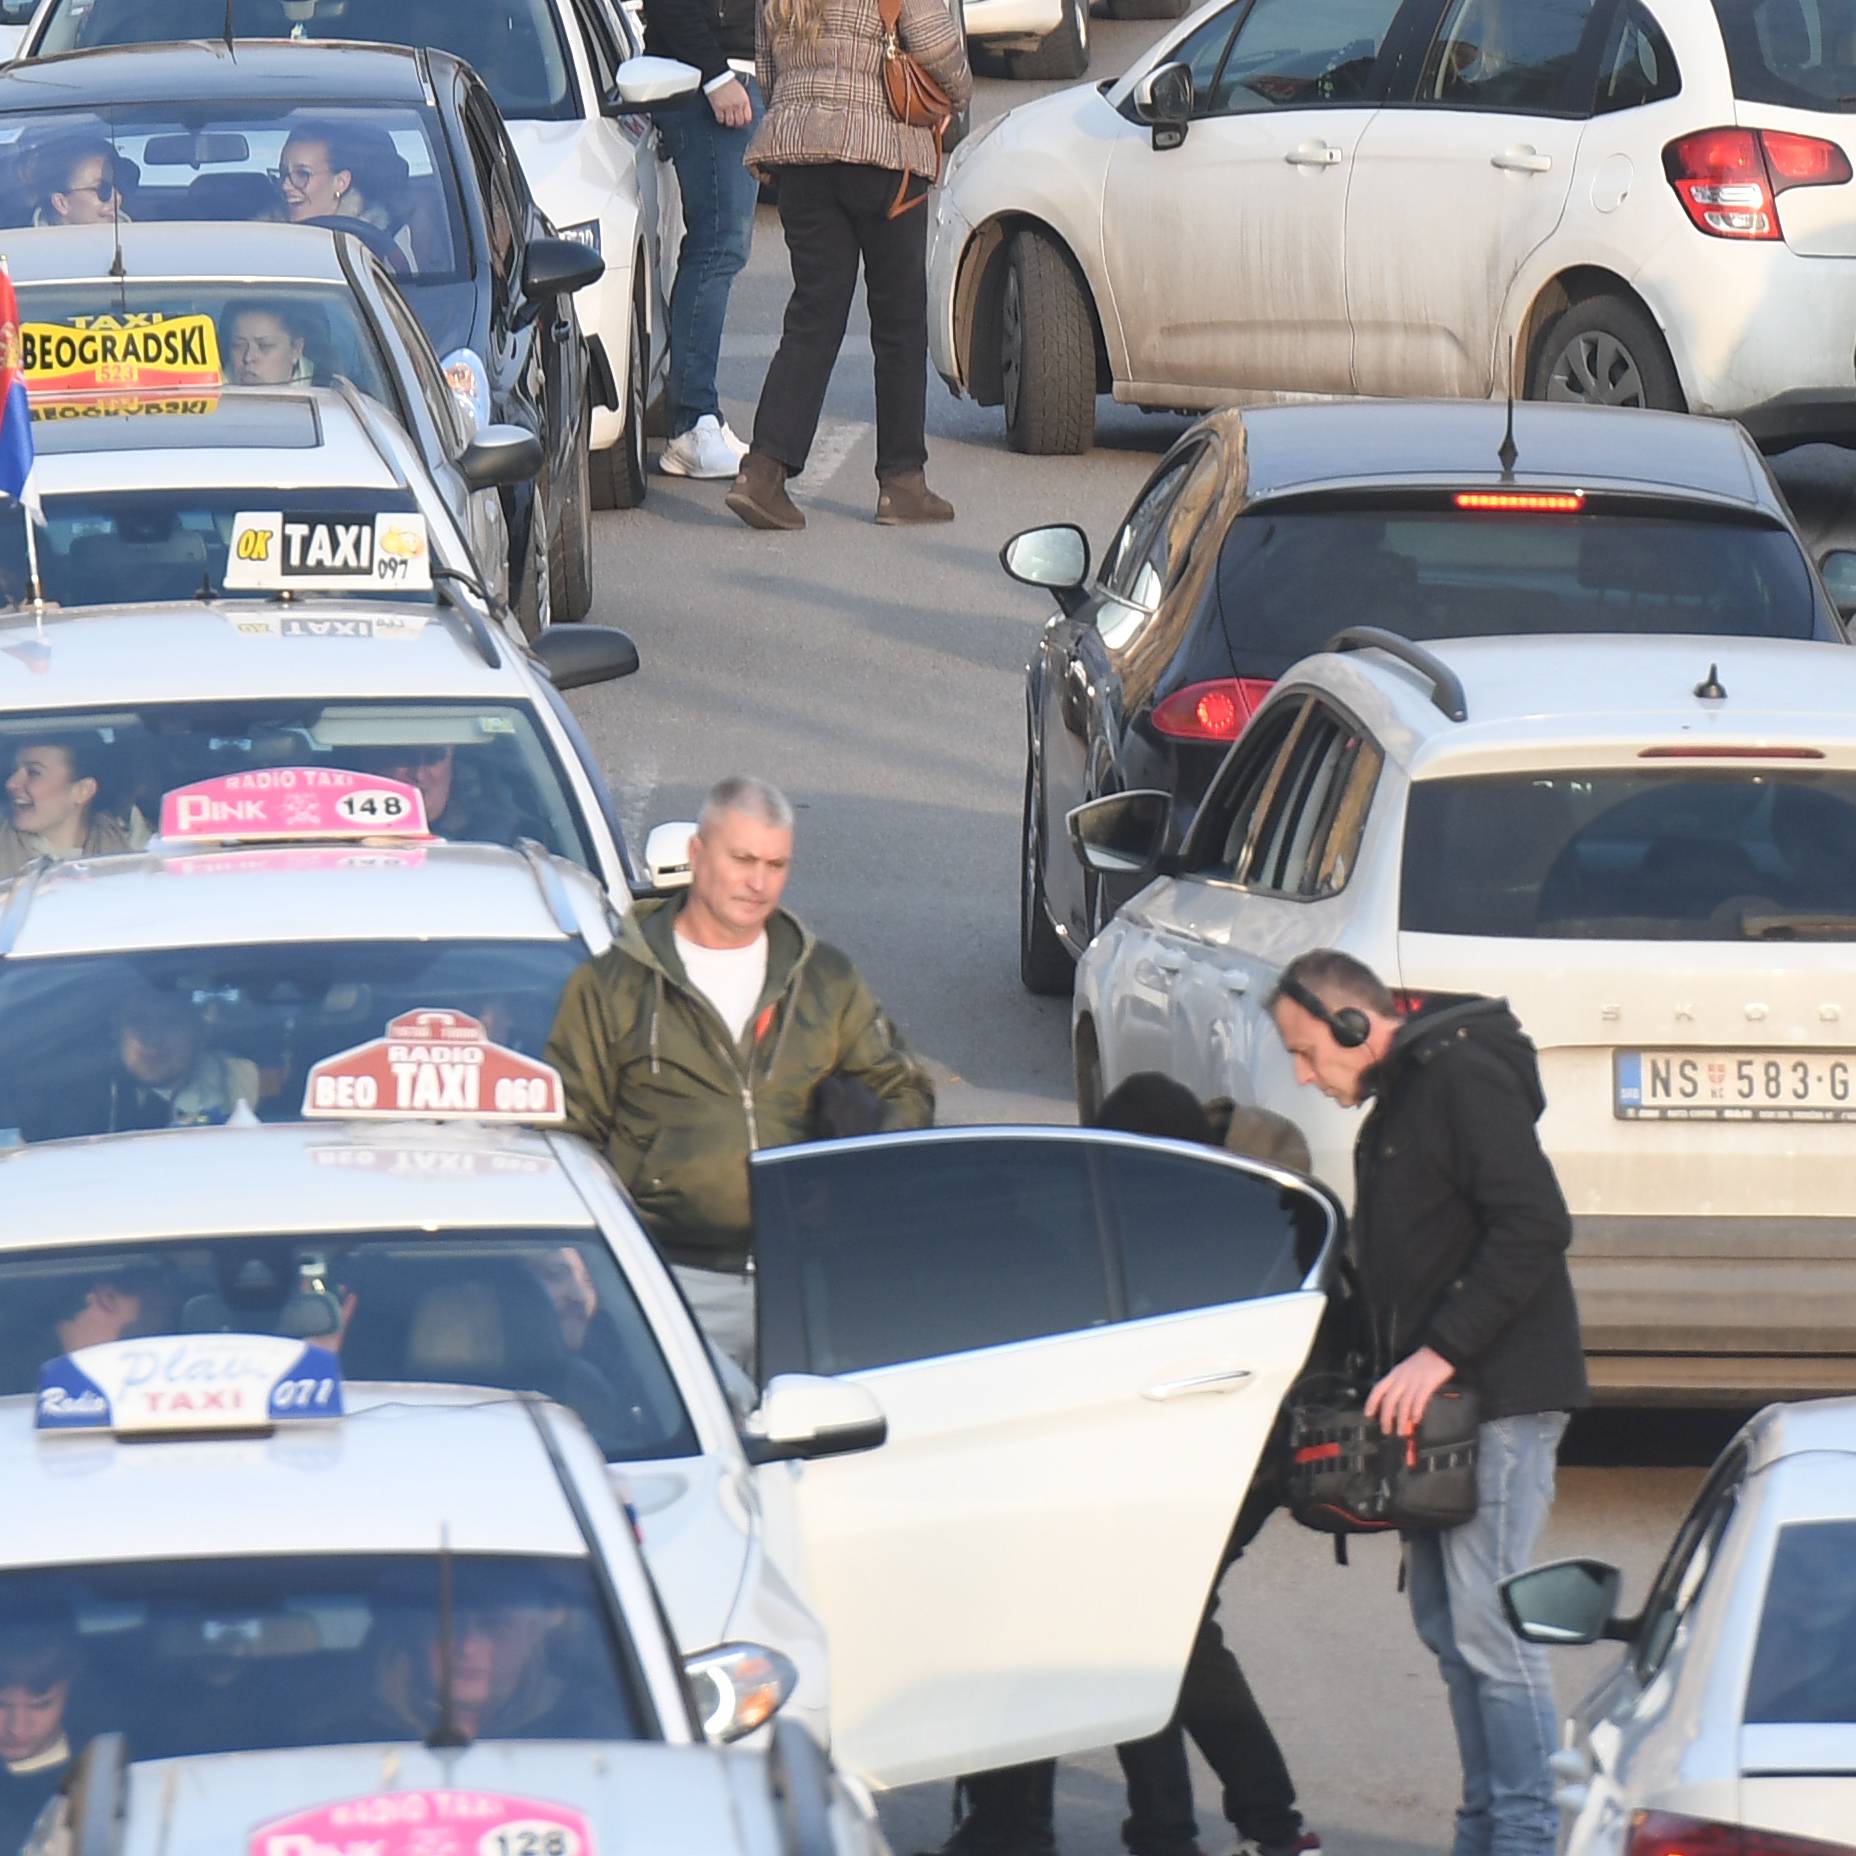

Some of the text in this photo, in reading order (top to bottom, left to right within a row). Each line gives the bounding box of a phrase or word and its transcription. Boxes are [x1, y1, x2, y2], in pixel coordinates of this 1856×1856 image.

[67, 312, 164, 330] TAXI
[22, 324, 208, 370] BEOGRADSKI
[101, 366, 134, 381] 523
[237, 523, 409, 580] OK TAXI 097
[226, 771, 353, 789] RADIO TAXI
[177, 795, 403, 830] PINK 148
[387, 1045, 485, 1064] RADIO
[314, 1063, 549, 1111] BEO TAXI 060
[1649, 1058, 1699, 1099] NS
[144, 1391, 243, 1411] TAXI
